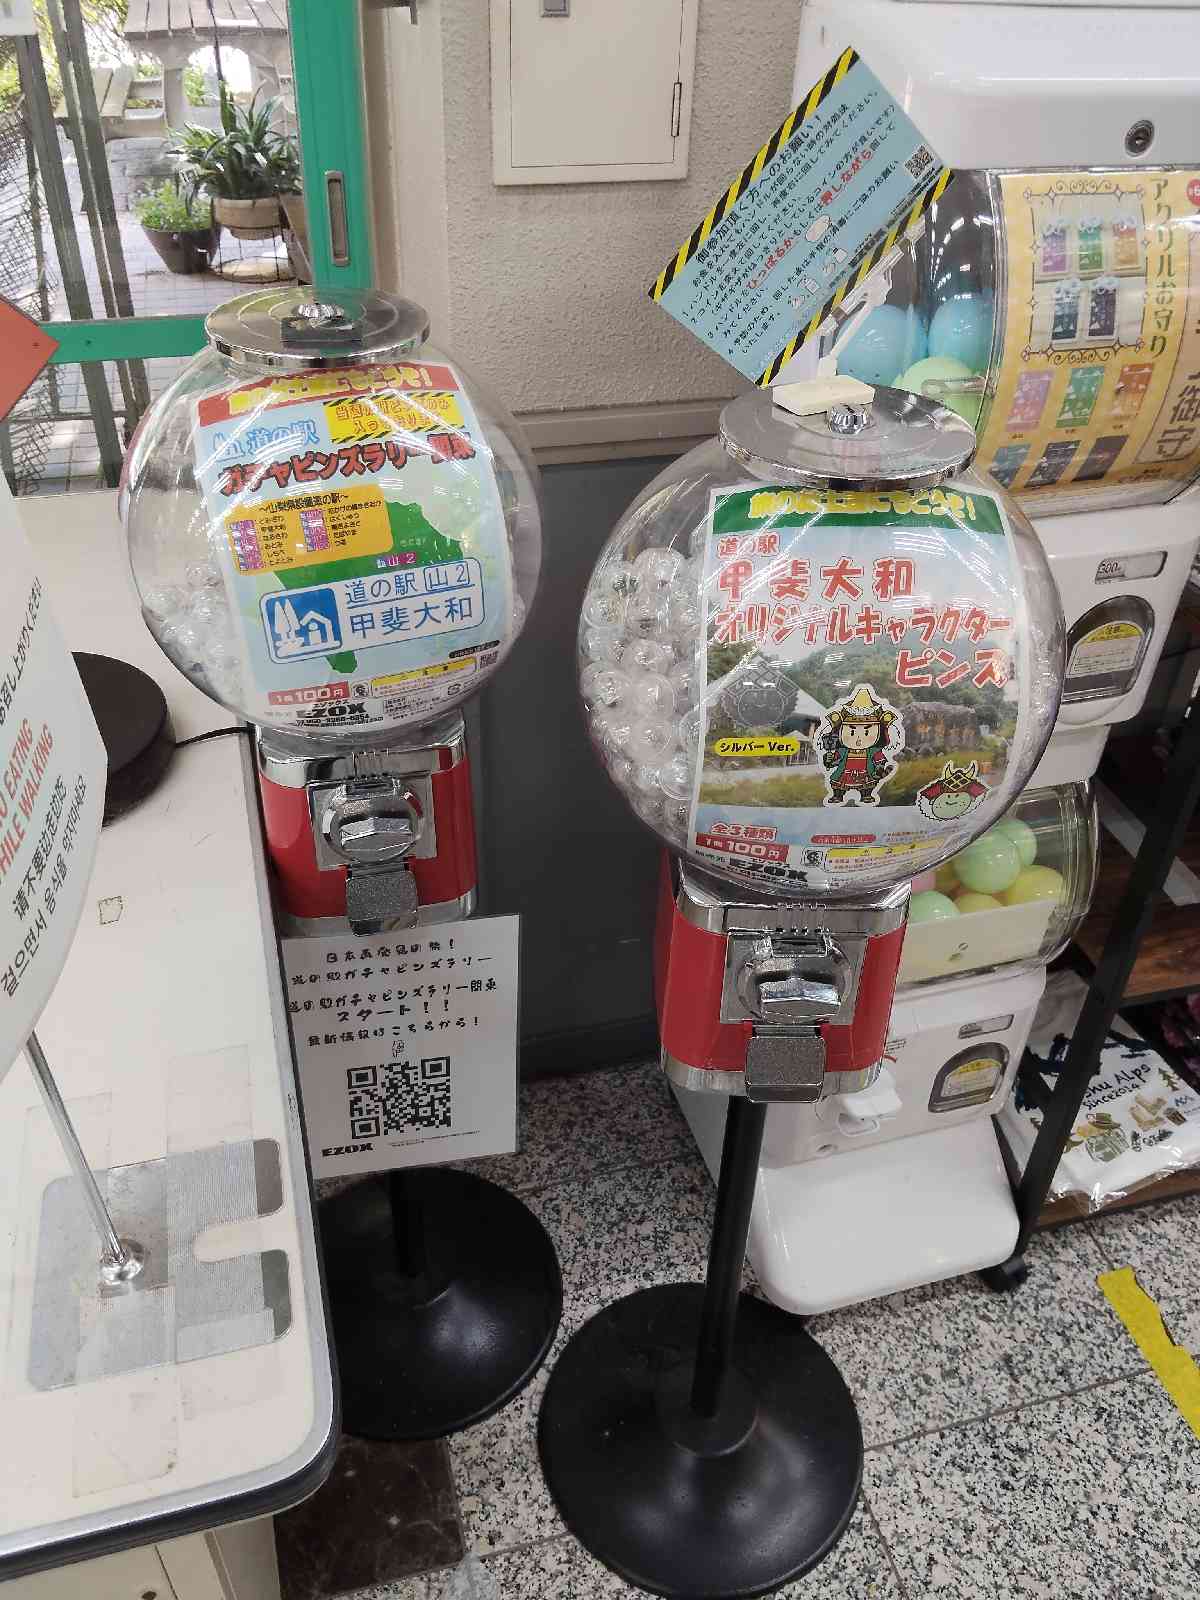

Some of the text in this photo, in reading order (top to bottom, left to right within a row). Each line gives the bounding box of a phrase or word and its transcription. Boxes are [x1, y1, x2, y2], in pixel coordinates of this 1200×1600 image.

[344, 571, 418, 604] 道の駅
[718, 557, 917, 602] 甲斐大和
[349, 596, 474, 640] 甲斐大和
[714, 603, 1014, 645] オリジナルキャラクター
[4, 717, 33, 801] EATING
[767, 740, 796, 753] Ver.
[18, 722, 53, 822] WALKING
[321, 1142, 376, 1158] EZOX
